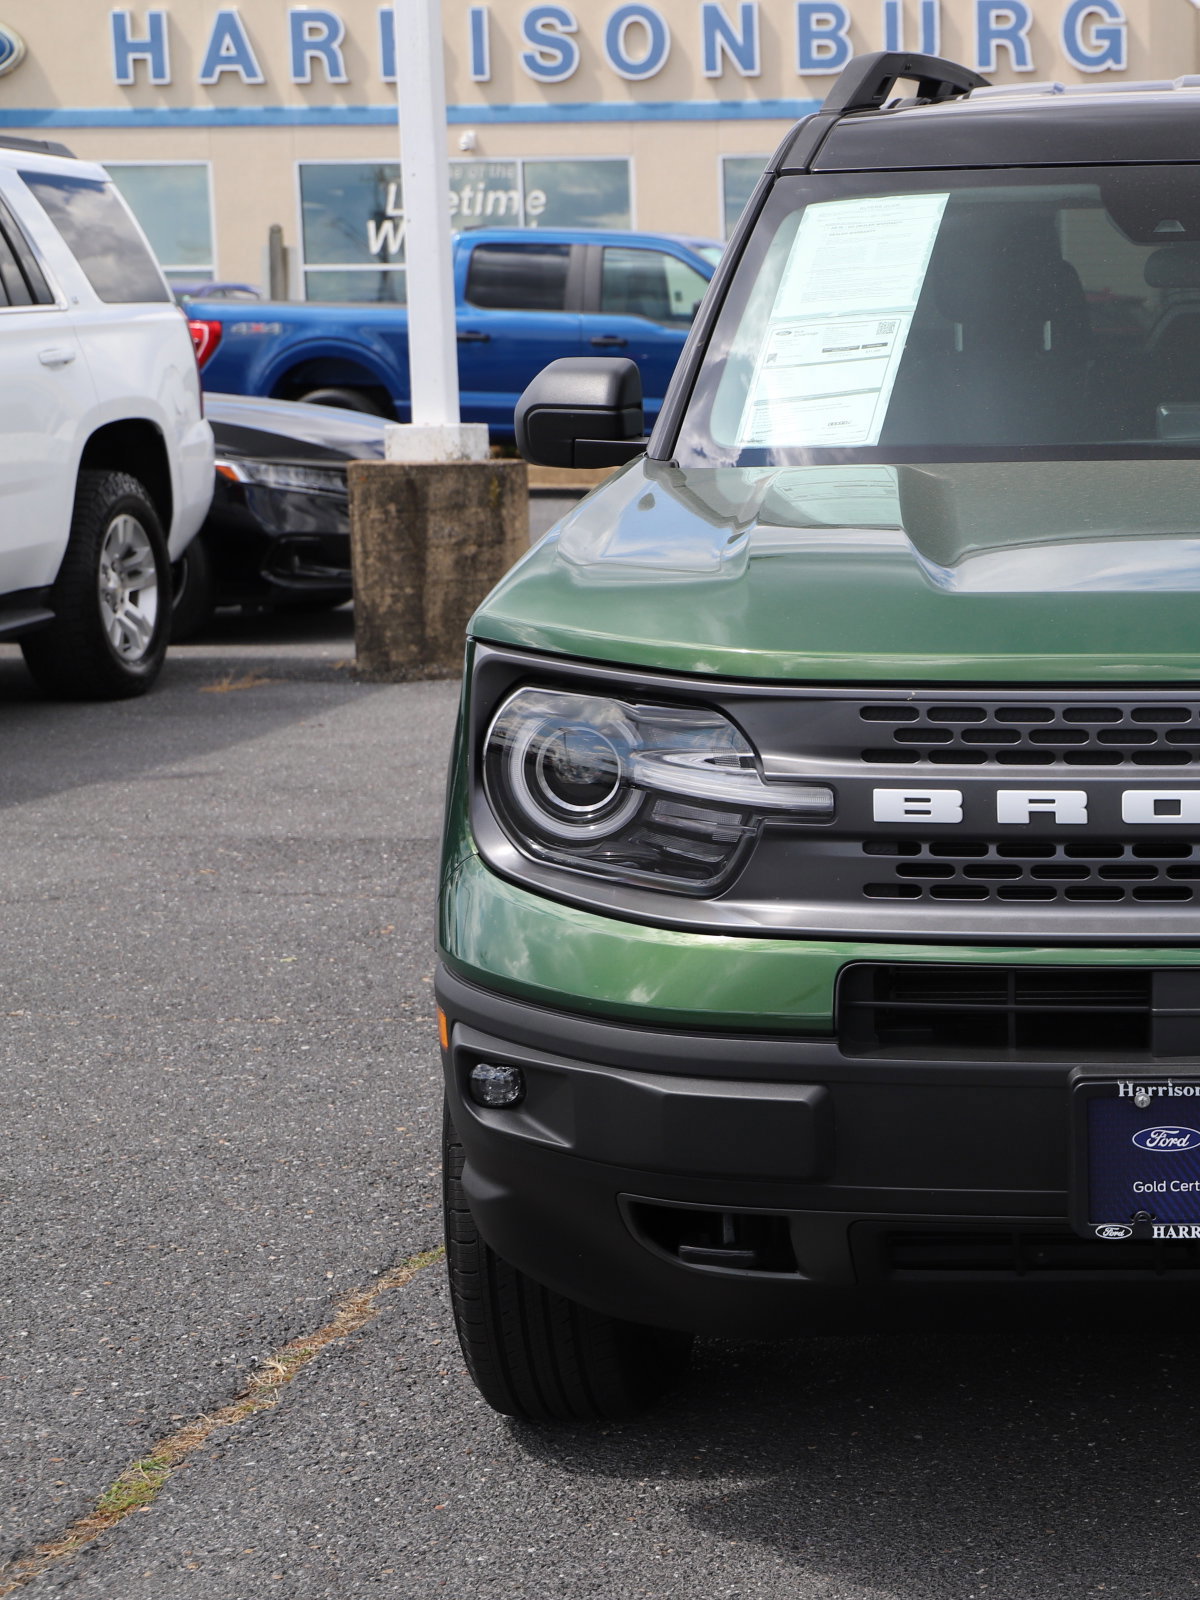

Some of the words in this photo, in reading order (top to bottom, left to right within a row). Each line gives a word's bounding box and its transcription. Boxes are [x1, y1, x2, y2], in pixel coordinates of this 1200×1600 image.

[110, 1, 1129, 86] HARISONBURG
[385, 182, 547, 217] Letime
[1146, 1129, 1191, 1148] Ford
[1133, 1180, 1166, 1193] Gold
[1102, 1226, 1126, 1237] Ford
